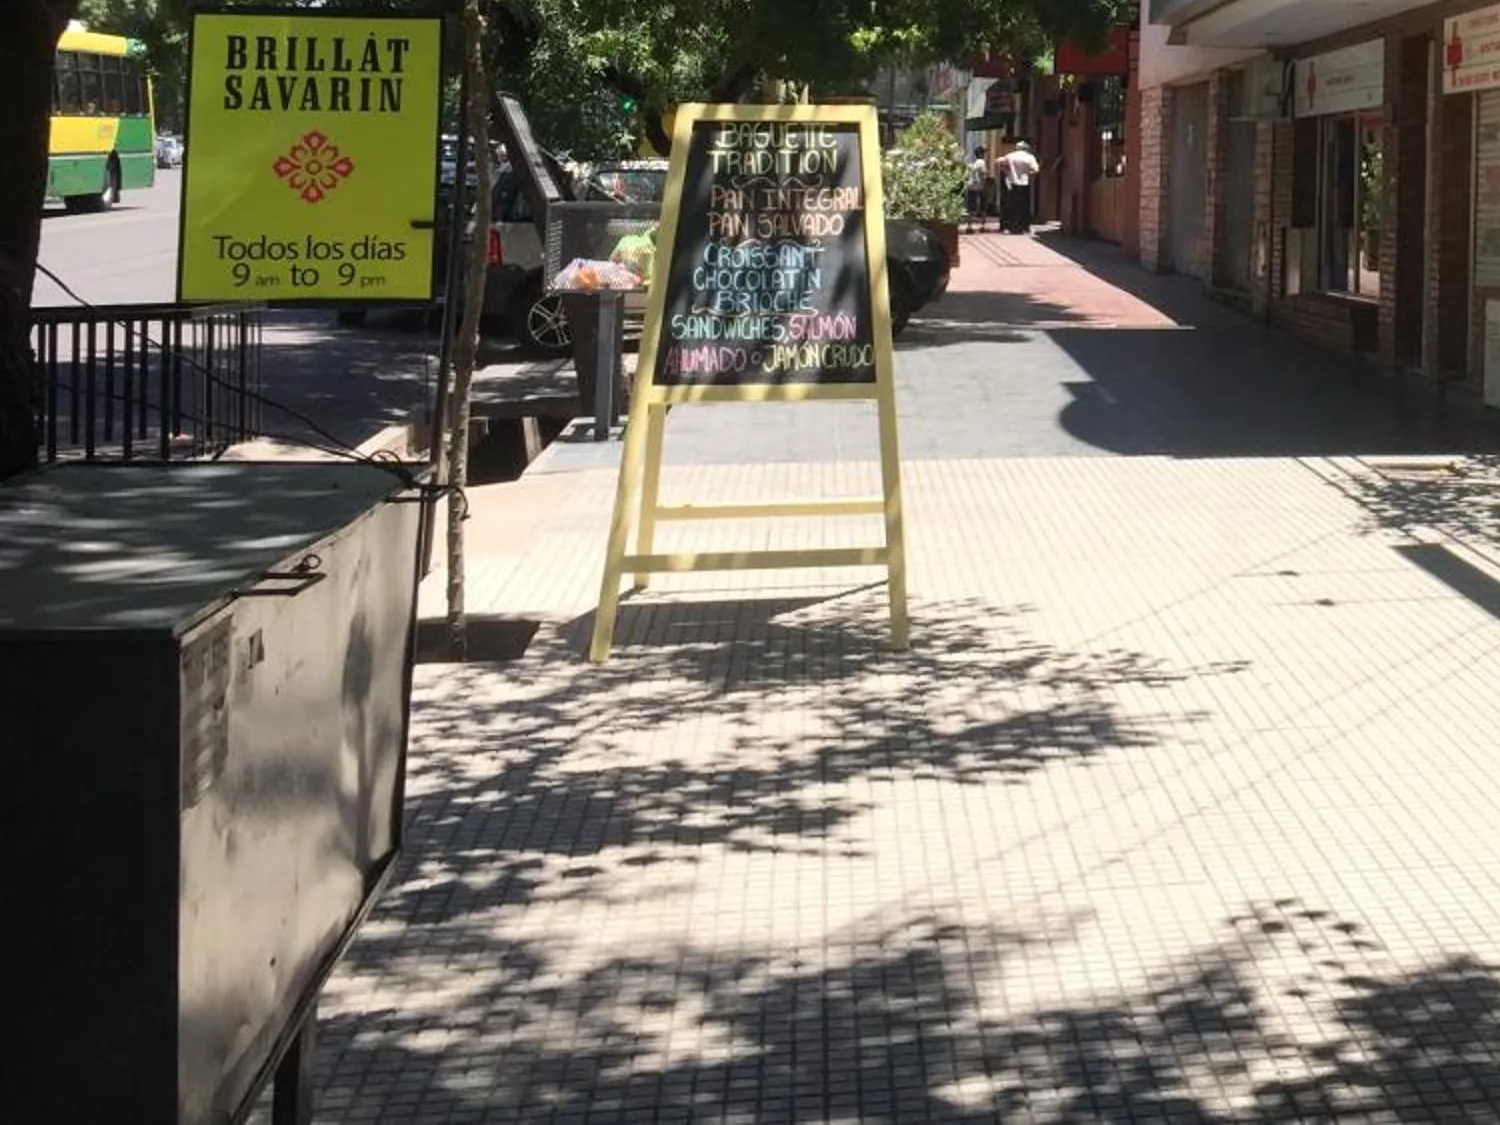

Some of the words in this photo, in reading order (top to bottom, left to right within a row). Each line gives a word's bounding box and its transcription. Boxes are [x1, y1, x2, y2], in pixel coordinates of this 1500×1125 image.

[223, 75, 404, 112] SAVARIN
[706, 149, 838, 175] TRADITION
[711, 186, 753, 211] PAN
[765, 186, 864, 211] INTEGRAL
[708, 212, 750, 239] PAN
[212, 235, 299, 261] Todos
[306, 235, 345, 261] los
[703, 242, 826, 269] CROISSANT
[290, 263, 320, 287] to
[715, 291, 813, 313] BRIOCHE
